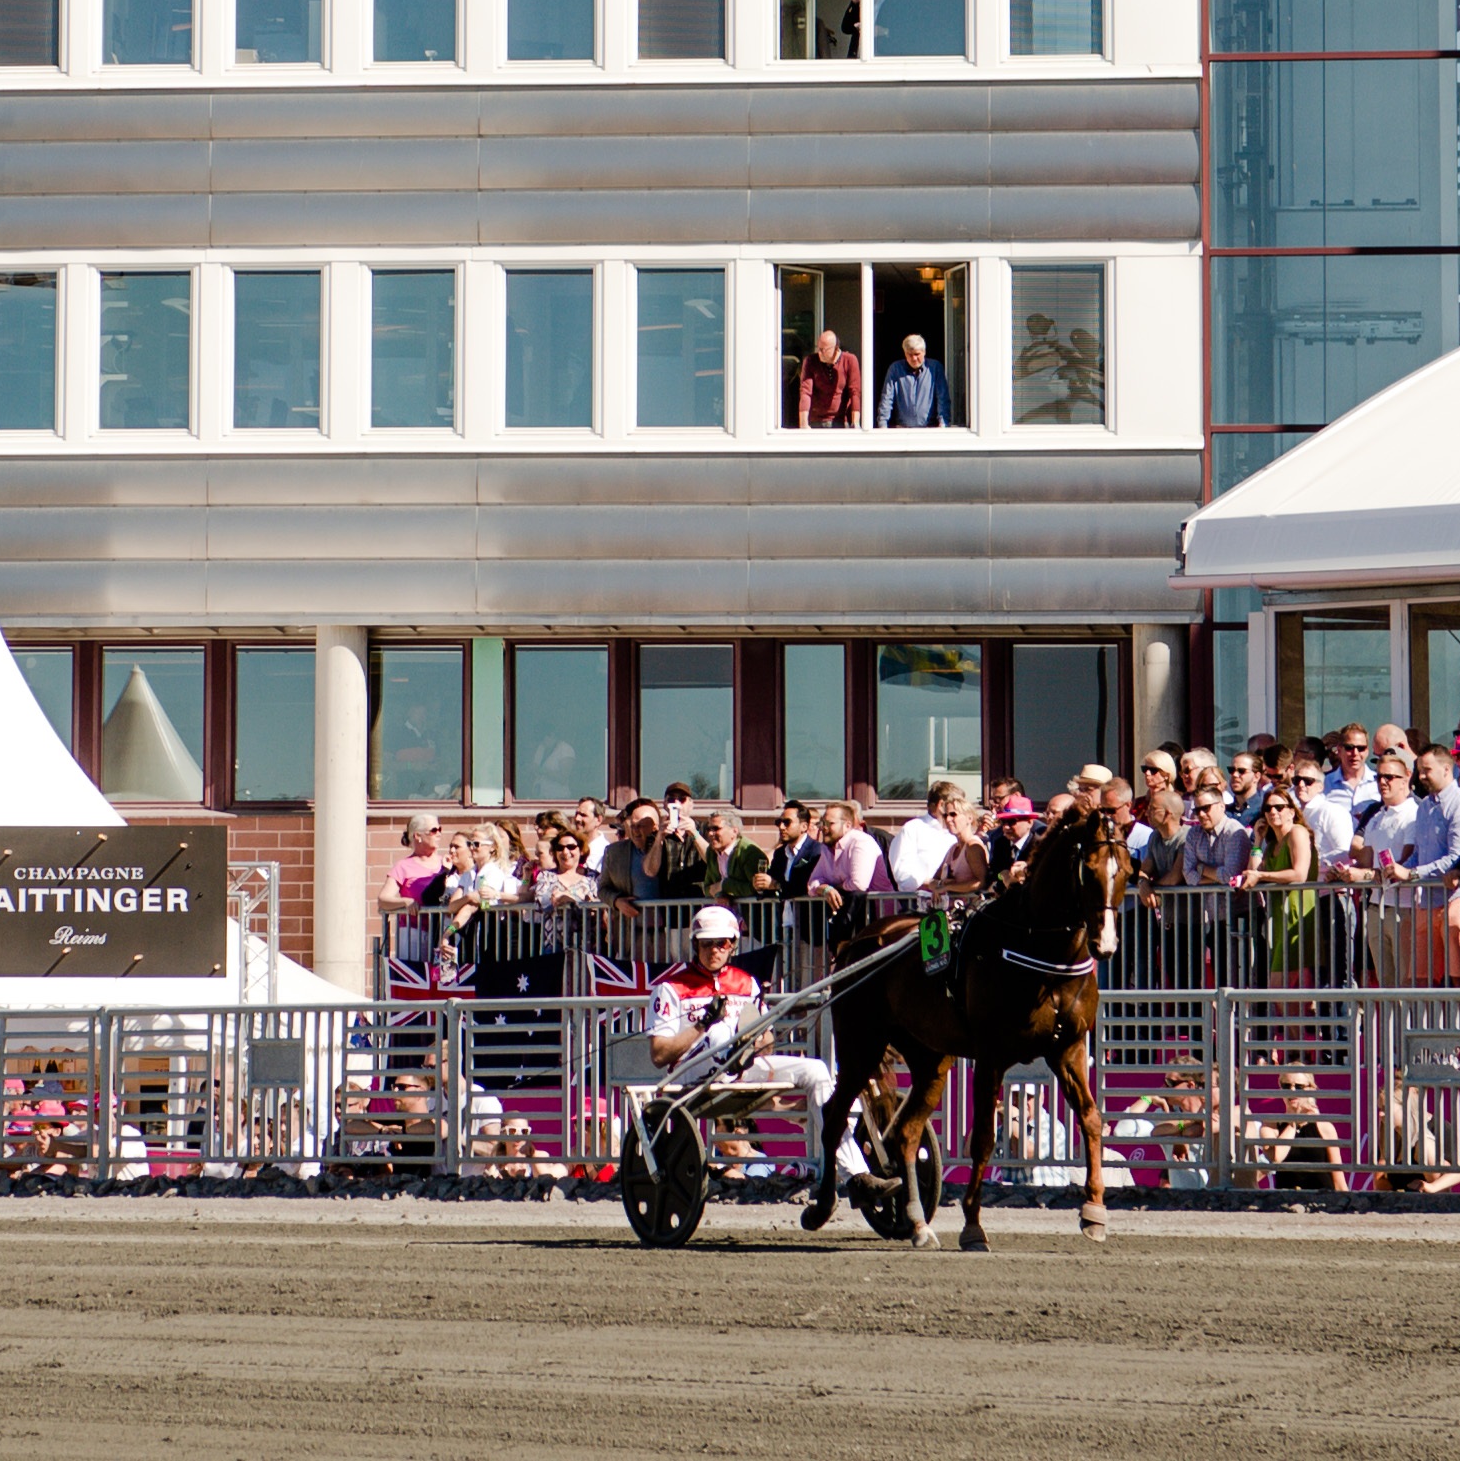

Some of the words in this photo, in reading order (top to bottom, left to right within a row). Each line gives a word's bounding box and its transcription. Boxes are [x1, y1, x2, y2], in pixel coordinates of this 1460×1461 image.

[14, 867, 144, 881] CHAMPAGNE
[49, 925, 107, 945] Reims
[925, 914, 944, 956] 3
